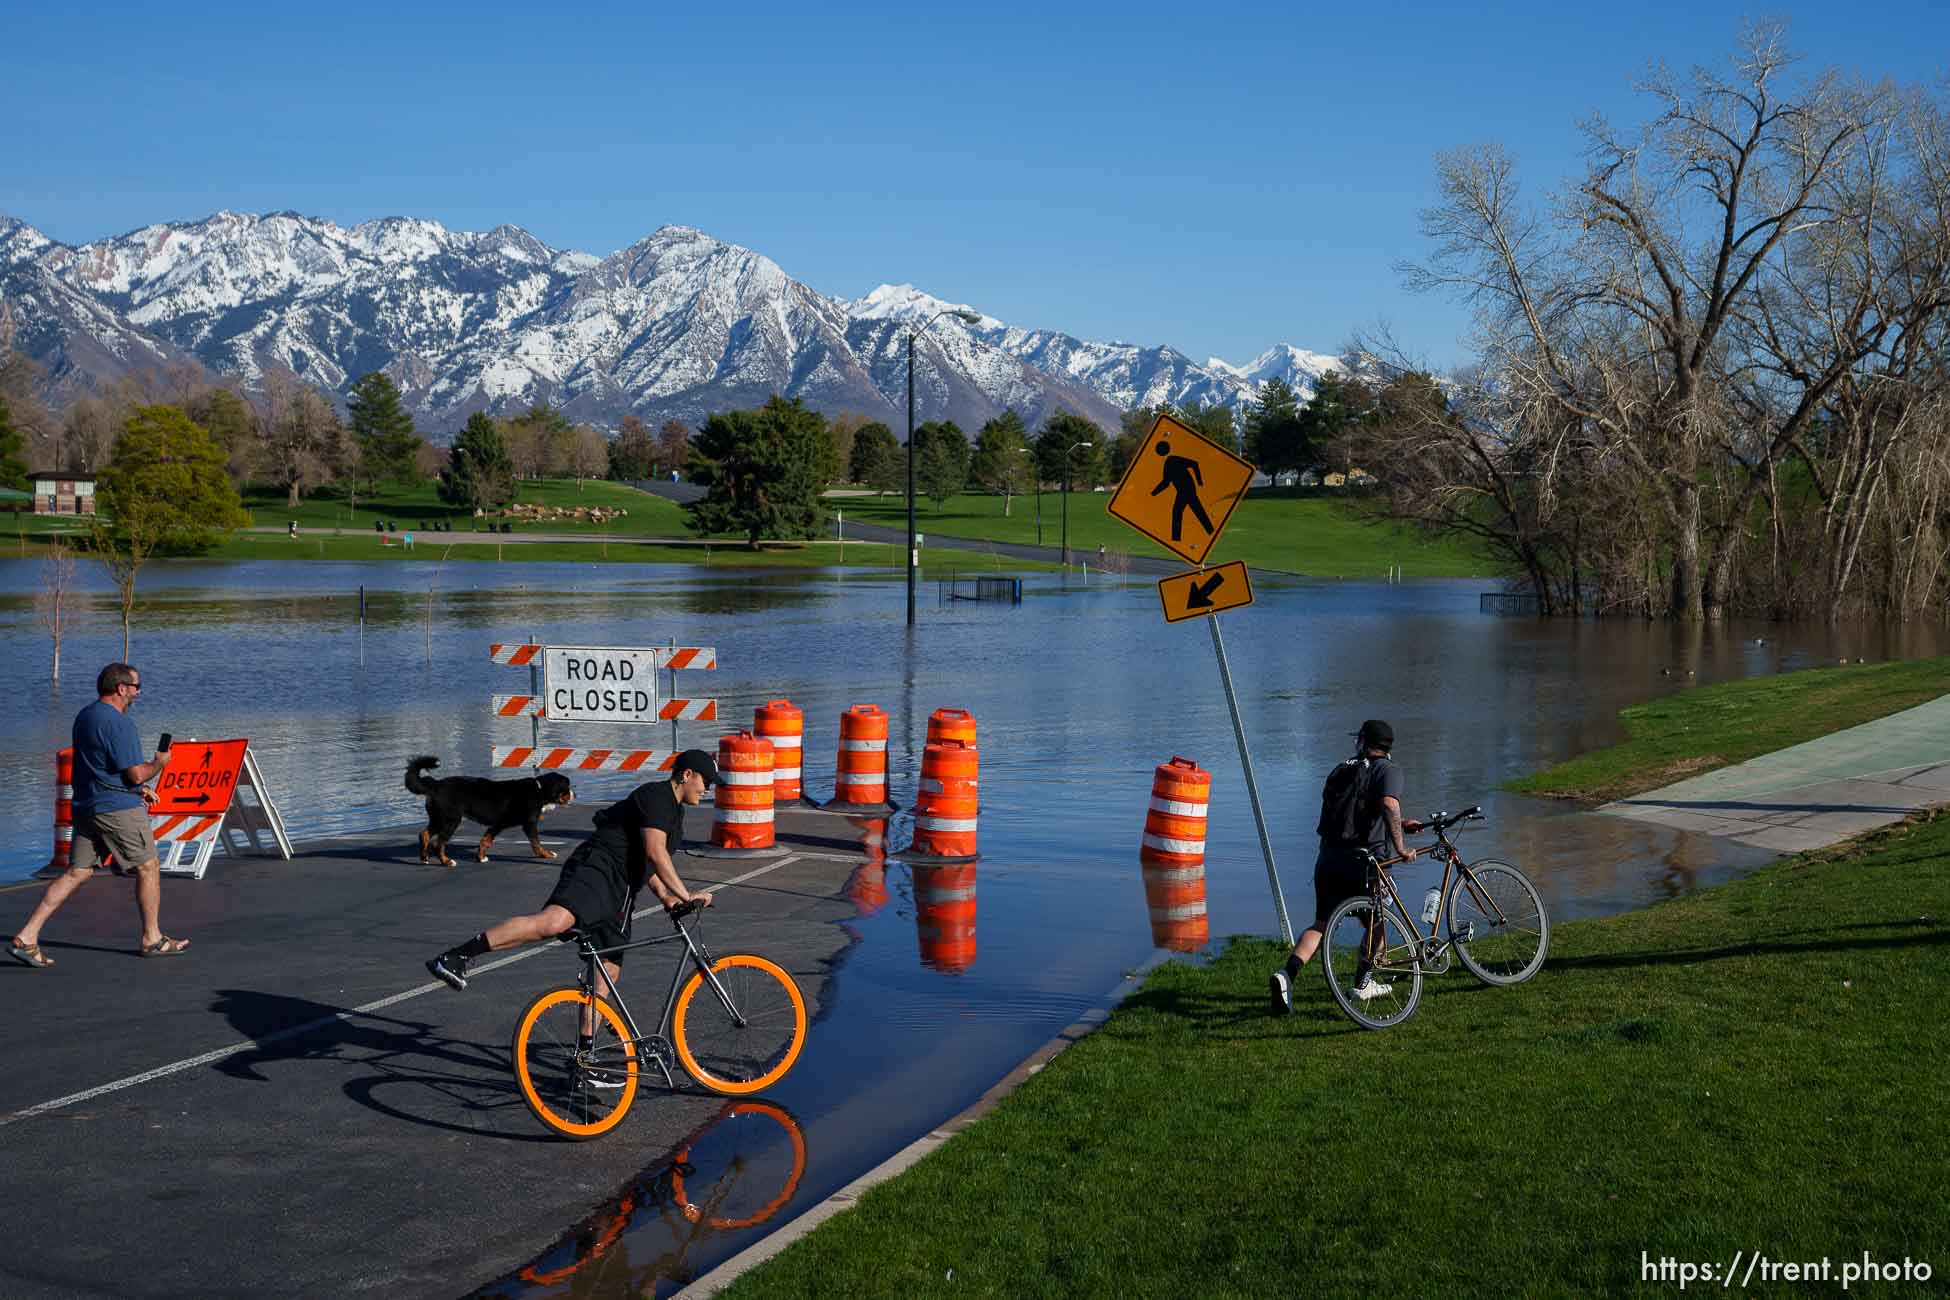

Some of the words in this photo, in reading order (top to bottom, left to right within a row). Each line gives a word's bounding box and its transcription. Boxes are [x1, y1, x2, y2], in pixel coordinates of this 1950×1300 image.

[567, 659, 634, 681] ROAD
[555, 689, 649, 712] CLOSED
[163, 770, 232, 789] DETOUR
